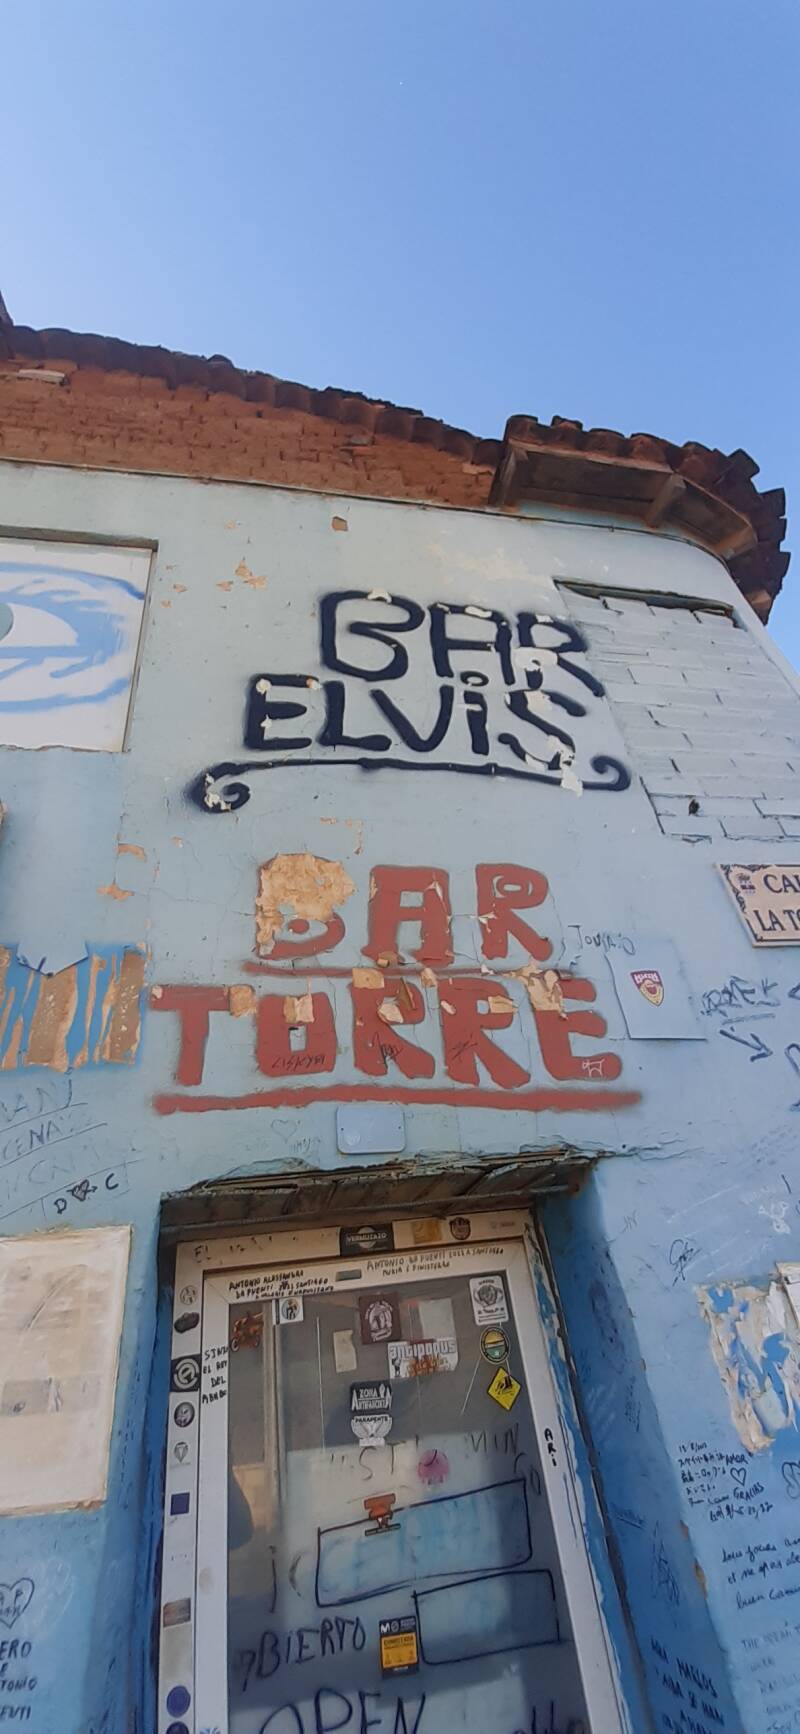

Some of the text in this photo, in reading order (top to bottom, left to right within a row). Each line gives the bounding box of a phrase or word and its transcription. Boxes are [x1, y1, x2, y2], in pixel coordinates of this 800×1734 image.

[319, 590, 606, 698] BAR
[753, 909, 786, 931] LA
[151, 970, 623, 1089] TORRE
